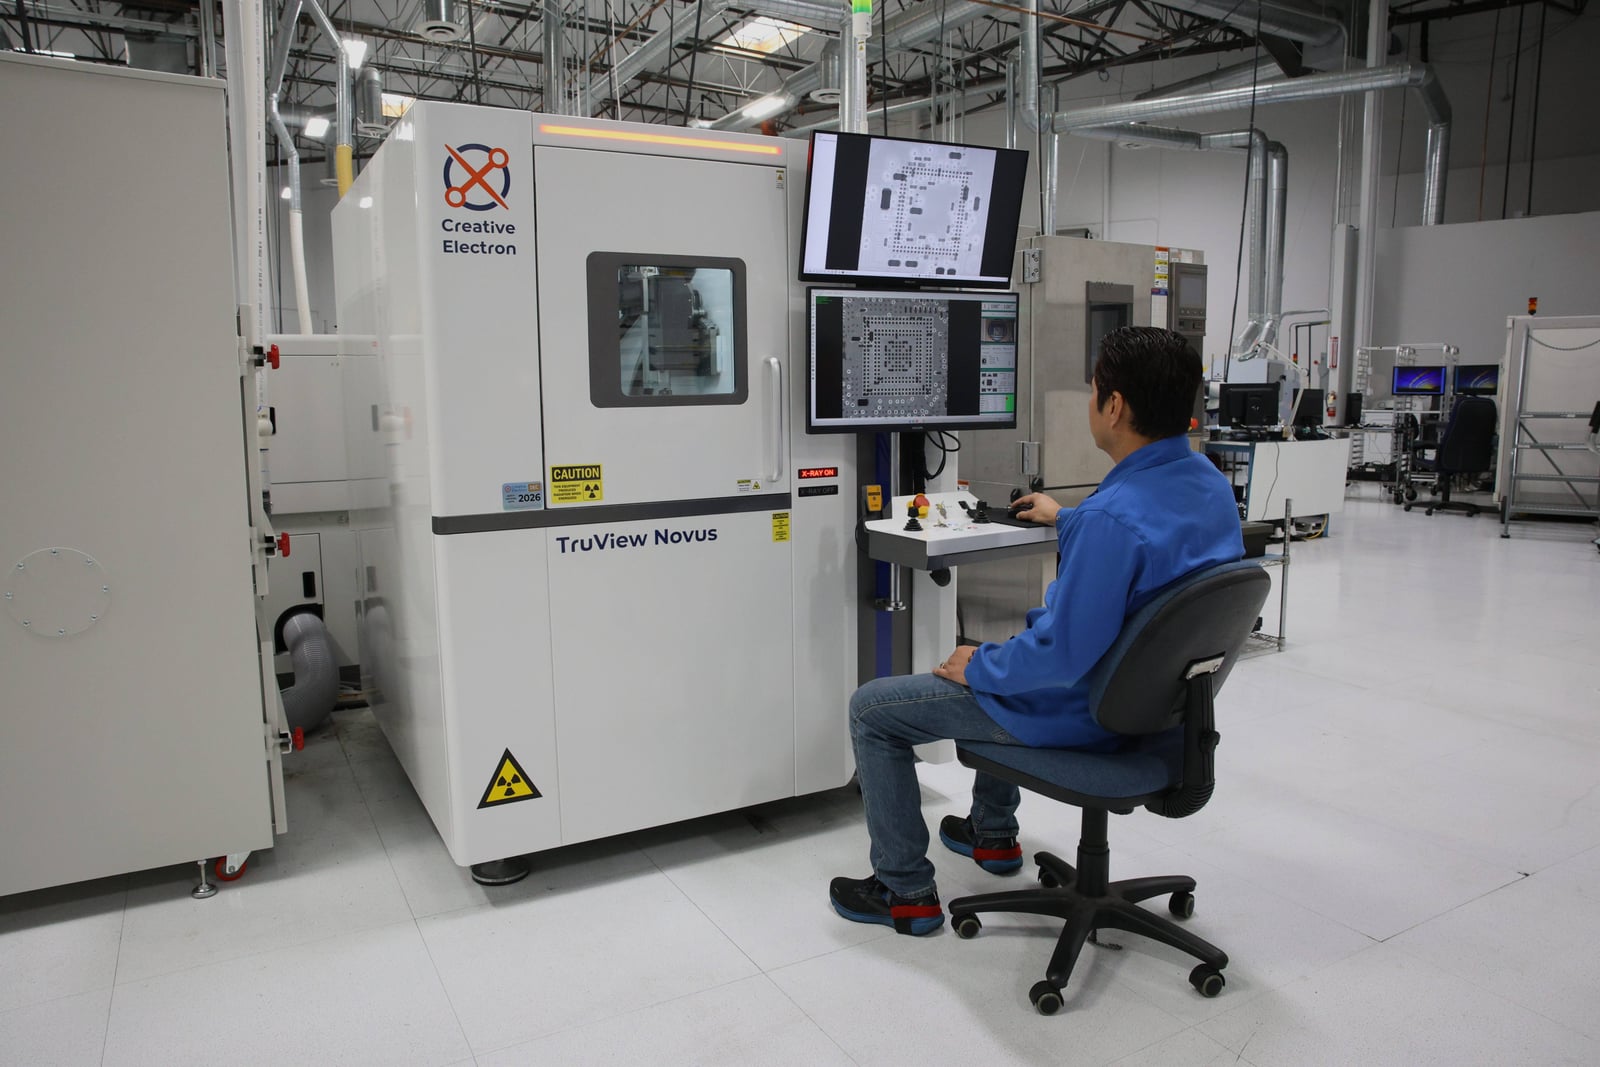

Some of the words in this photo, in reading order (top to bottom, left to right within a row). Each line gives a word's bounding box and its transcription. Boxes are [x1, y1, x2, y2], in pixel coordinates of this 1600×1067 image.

[441, 218, 516, 235] Creative
[443, 240, 516, 255] Electron
[553, 467, 600, 480] CAUTION
[801, 469, 823, 477] X-RAY
[518, 493, 541, 503] 2026
[556, 532, 648, 554] TruView
[654, 528, 718, 545] Novus
